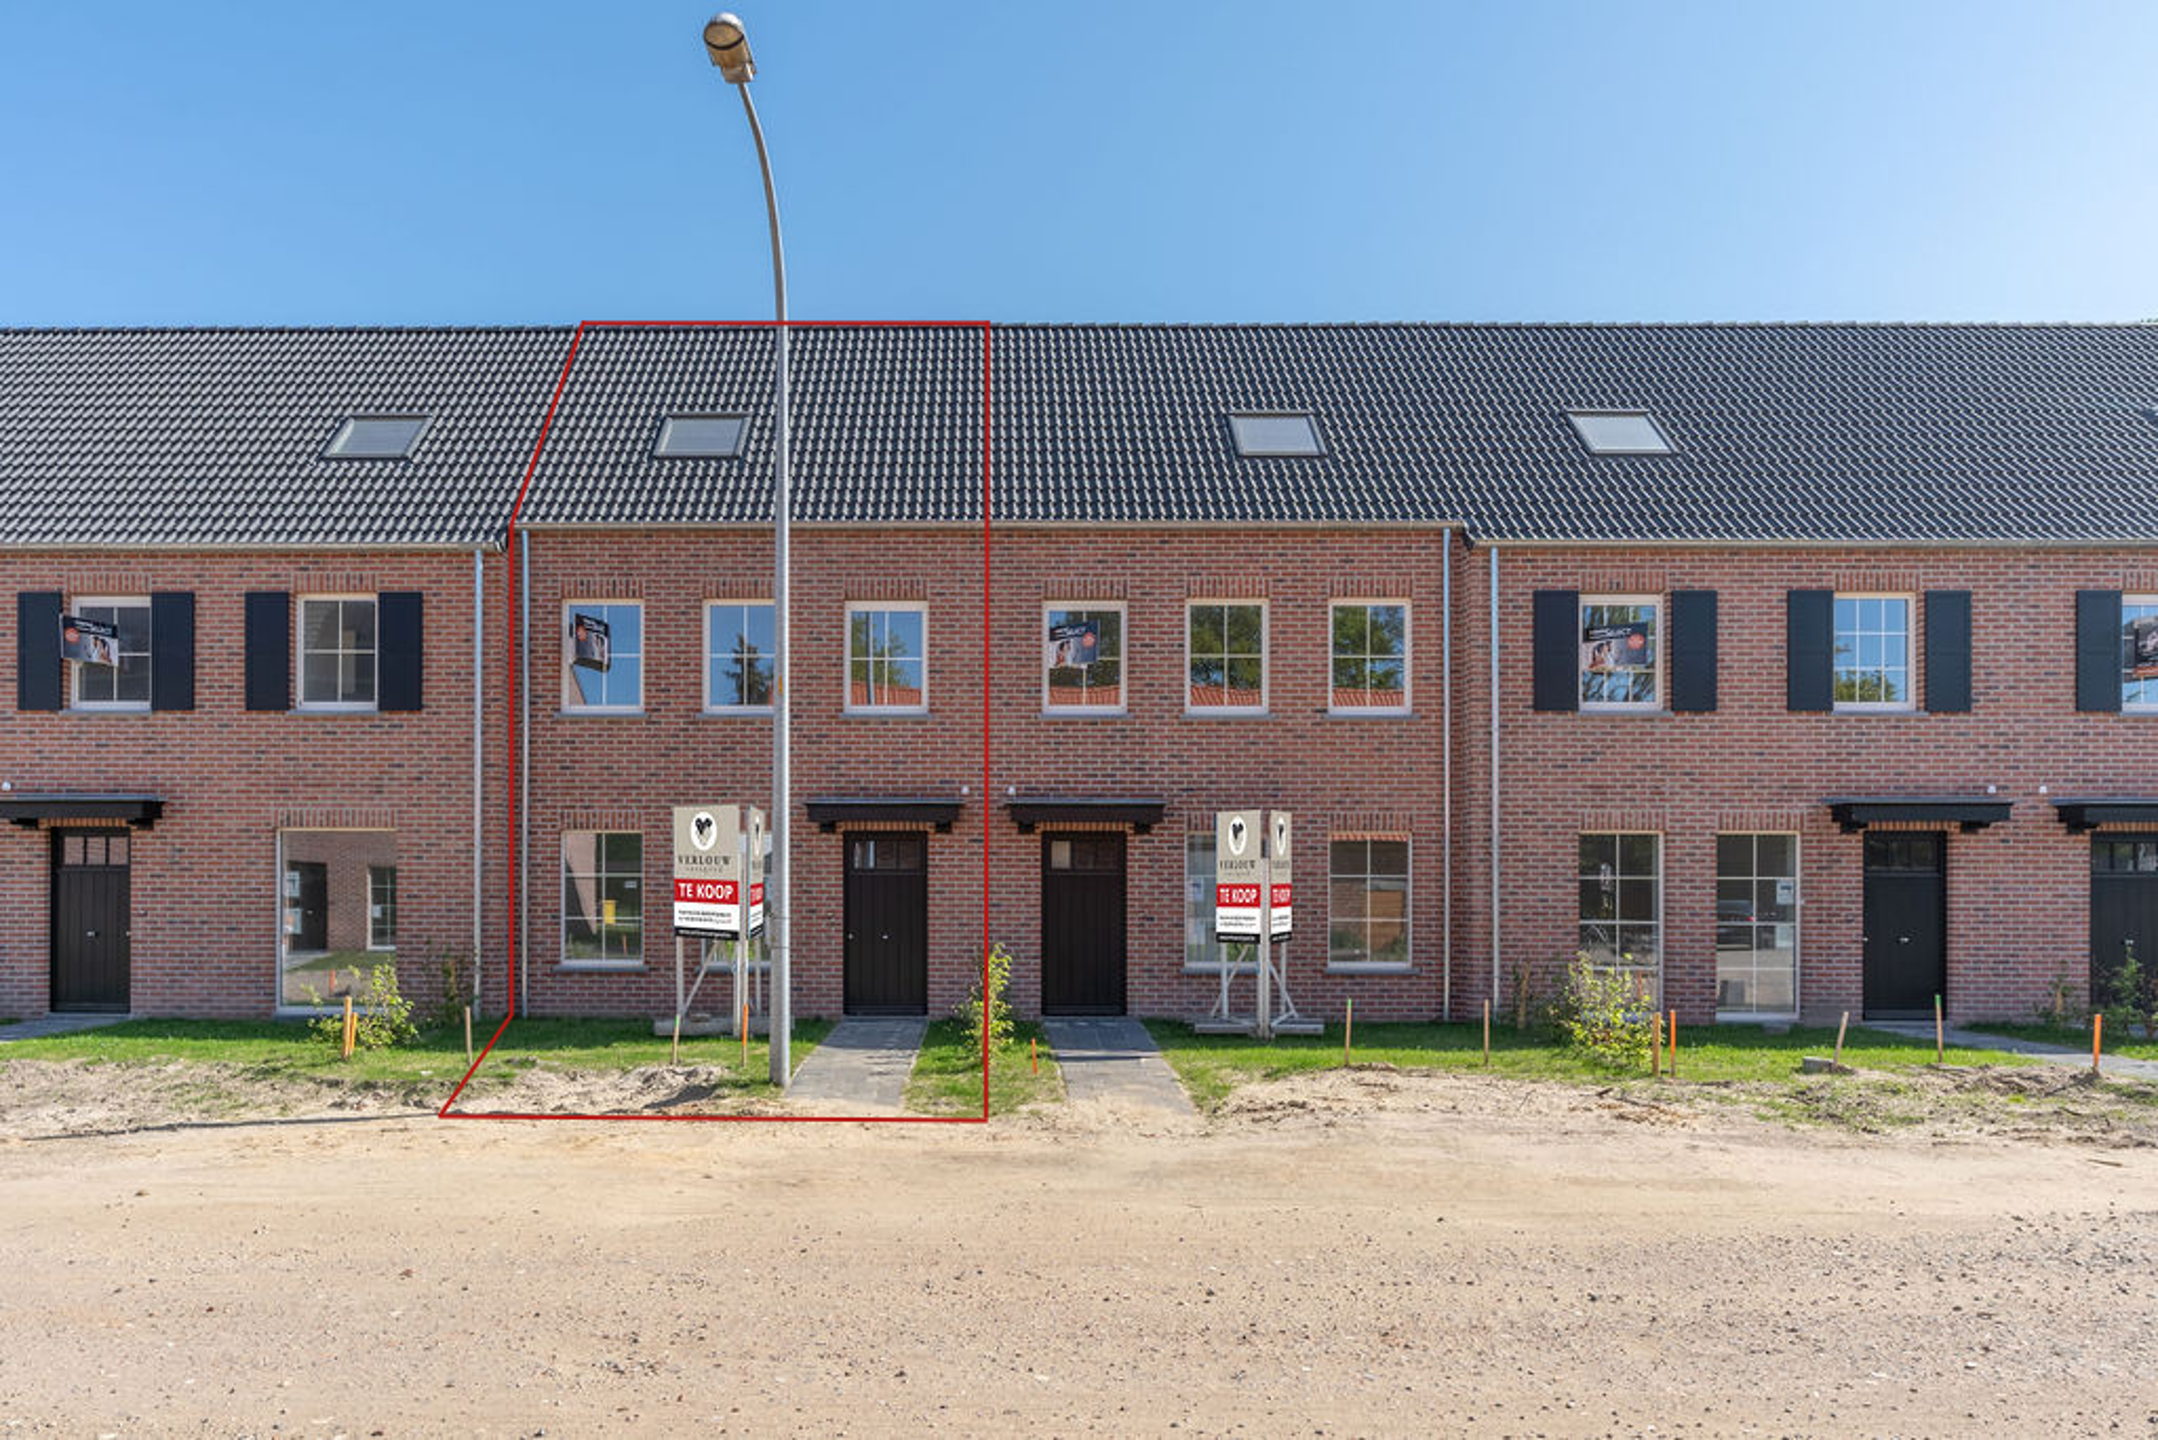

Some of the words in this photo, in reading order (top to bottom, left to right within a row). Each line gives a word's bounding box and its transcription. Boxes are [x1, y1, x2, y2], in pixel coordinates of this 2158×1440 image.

[678, 855, 731, 865] VERLOUW
[678, 883, 693, 898] TE
[697, 884, 733, 899] KOOP
[1219, 888, 1229, 903] TE
[1232, 888, 1257, 903] KOOP
